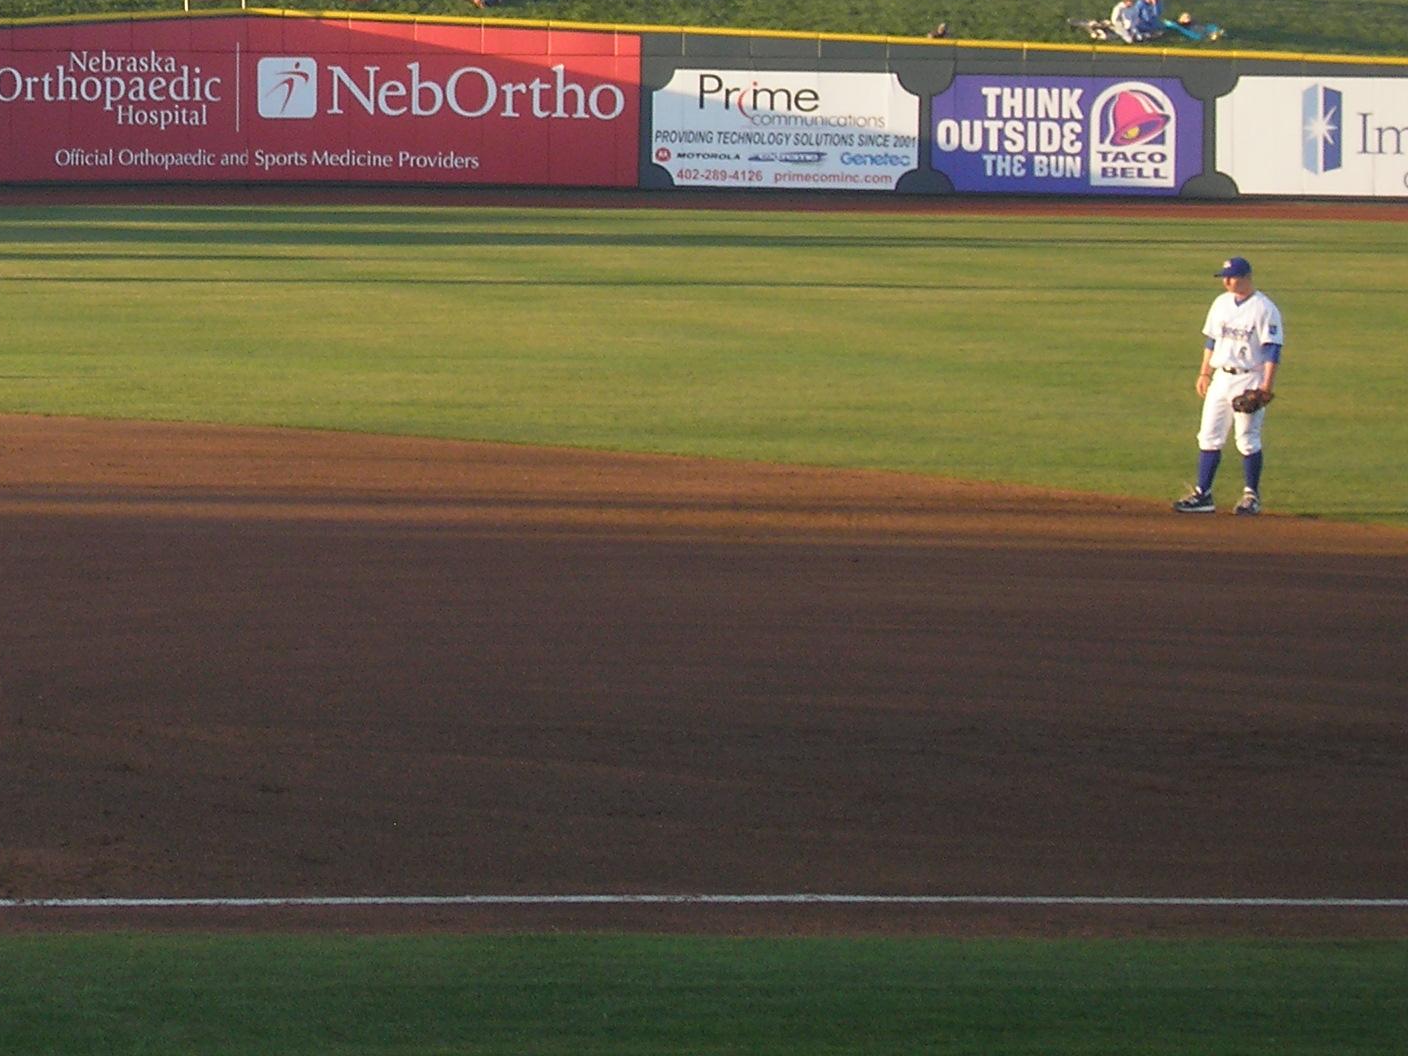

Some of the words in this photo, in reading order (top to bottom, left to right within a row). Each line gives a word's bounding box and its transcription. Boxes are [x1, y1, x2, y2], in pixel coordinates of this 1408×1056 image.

[68, 51, 176, 73] Nebraska
[326, 61, 624, 120] NebOrtho
[699, 74, 819, 112] Prime
[981, 86, 1084, 120] THINK
[116, 105, 207, 130] Hospital
[752, 112, 886, 128] communications
[654, 130, 714, 144] PROVIDING
[716, 130, 792, 145] TECHNOLOGY
[794, 133, 855, 147] SOLUTIONS
[857, 135, 891, 148] SINCE
[893, 135, 916, 148] 2001
[936, 120, 1083, 154] OUTSIDE
[55, 149, 113, 166] Official
[118, 149, 215, 170] Orthopaedic
[220, 151, 248, 166] and
[255, 150, 307, 170] Sports
[312, 150, 392, 168] Medicine
[399, 151, 479, 169] Providers
[677, 152, 741, 161] MOTOROLA
[840, 151, 910, 166] Genetec
[983, 154, 1026, 178] THE
[1034, 155, 1082, 179] BUN
[1097, 150, 1167, 164] TACO
[676, 169, 763, 182] 402-289-4126
[774, 170, 892, 184] primecominc.com
[1100, 167, 1168, 180] BELL
